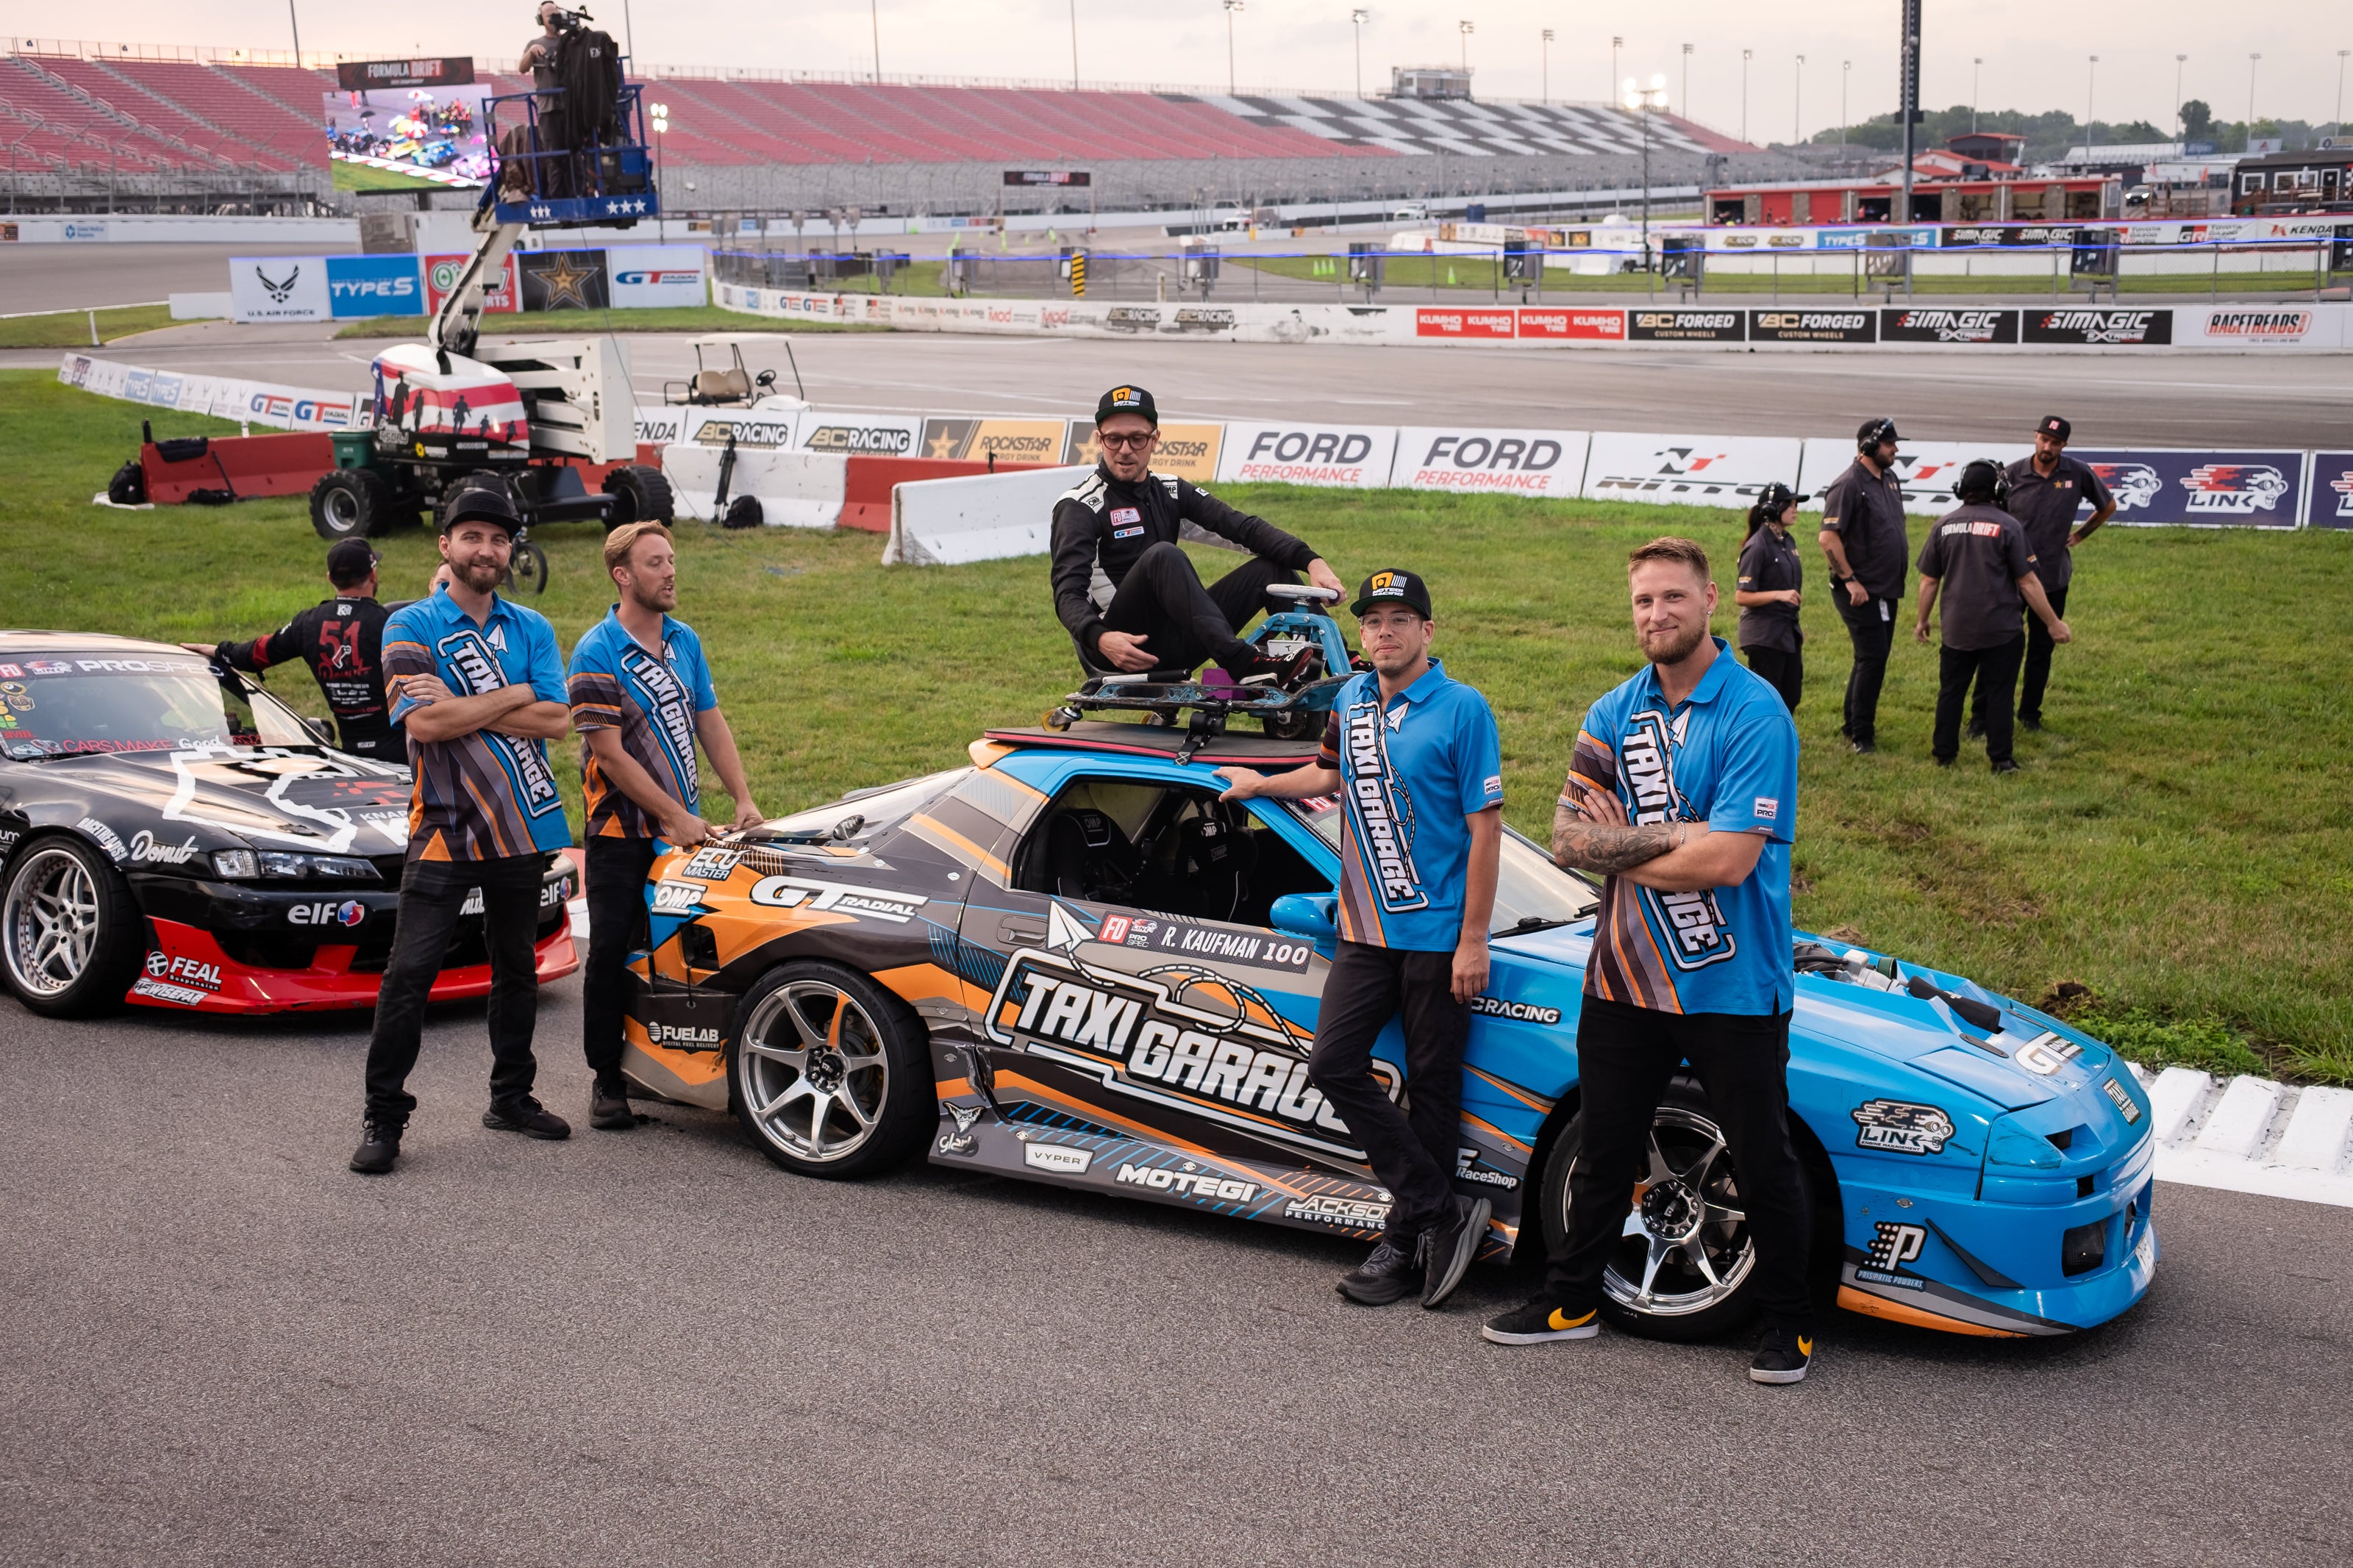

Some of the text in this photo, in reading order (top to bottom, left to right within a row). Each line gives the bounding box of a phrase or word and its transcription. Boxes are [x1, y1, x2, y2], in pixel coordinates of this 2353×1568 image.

[368, 60, 441, 78] FORMULA DRIFT
[2290, 225, 2332, 234] KENDA
[616, 271, 700, 284] GT
[283, 309, 315, 317] FORCE
[1419, 315, 1462, 325] KUMHO
[1468, 315, 1512, 326] KUMHO
[1521, 315, 1567, 326] KUMHO
[1573, 316, 1621, 326] KUMHO
[1675, 314, 1735, 328] FORGED
[1801, 314, 1865, 329] FORGED
[1904, 312, 2002, 329] SIMAGIC
[2047, 312, 2154, 329] SIMAGIC
[2209, 313, 2300, 334] RACETREADS
[251, 393, 293, 414] GT
[295, 400, 351, 422] GT
[635, 422, 676, 440] ENDA
[980, 435, 1052, 452] ROCKSTAR
[1154, 440, 1208, 457] CKSTAR
[1247, 432, 1372, 464] FORD
[985, 451, 1041, 462] EERGY DRINK
[1422, 436, 1563, 470] FORD
[1149, 457, 1196, 468] ERGY DRINK
[1239, 464, 1363, 482] PERFORMANCE
[1414, 470, 1552, 490] PERFORMANCE
[2189, 493, 2254, 507] LINK
[1940, 522, 2000, 537] FORMULA DRIFT
[318, 620, 361, 667] 51
[3, 663, 22, 676] FD
[632, 654, 681, 710] TAXI
[63, 740, 115, 753] CARS
[111, 740, 175, 752] MAKE
[178, 735, 225, 748] Good
[660, 701, 699, 792] GARAGE
[1349, 714, 1379, 775] TAXI
[1624, 725, 1668, 809] TAXI
[130, 829, 199, 864] Donut
[1355, 776, 1416, 904] GARAGE
[691, 848, 743, 870] ECU
[683, 865, 729, 880] MASTER
[540, 881, 560, 907] elf
[655, 883, 703, 909] OMP
[288, 902, 338, 926] elf
[840, 895, 916, 917] RADIAL
[1102, 916, 1129, 940] FD
[1126, 939, 1149, 948] SPEC
[1129, 934, 1148, 942] PRO
[1161, 926, 1309, 966] R. KAUFMAN 100
[170, 956, 222, 985] FEAL
[169, 975, 219, 991] Suspension
[149, 984, 206, 1003] WISEFAB
[1017, 971, 1143, 1056] TAXI
[1484, 998, 1559, 1023] RACING
[1863, 1127, 1924, 1148] LINK
[1882, 1142, 1921, 1151] MANAGEMENT
[1034, 1152, 1082, 1166] VYPER
[1116, 1164, 1256, 1202] MOTEGI
[1285, 1210, 1387, 1230] PERFORMANC
[1858, 1270, 1924, 1288] PRISMATIC POWDERS
